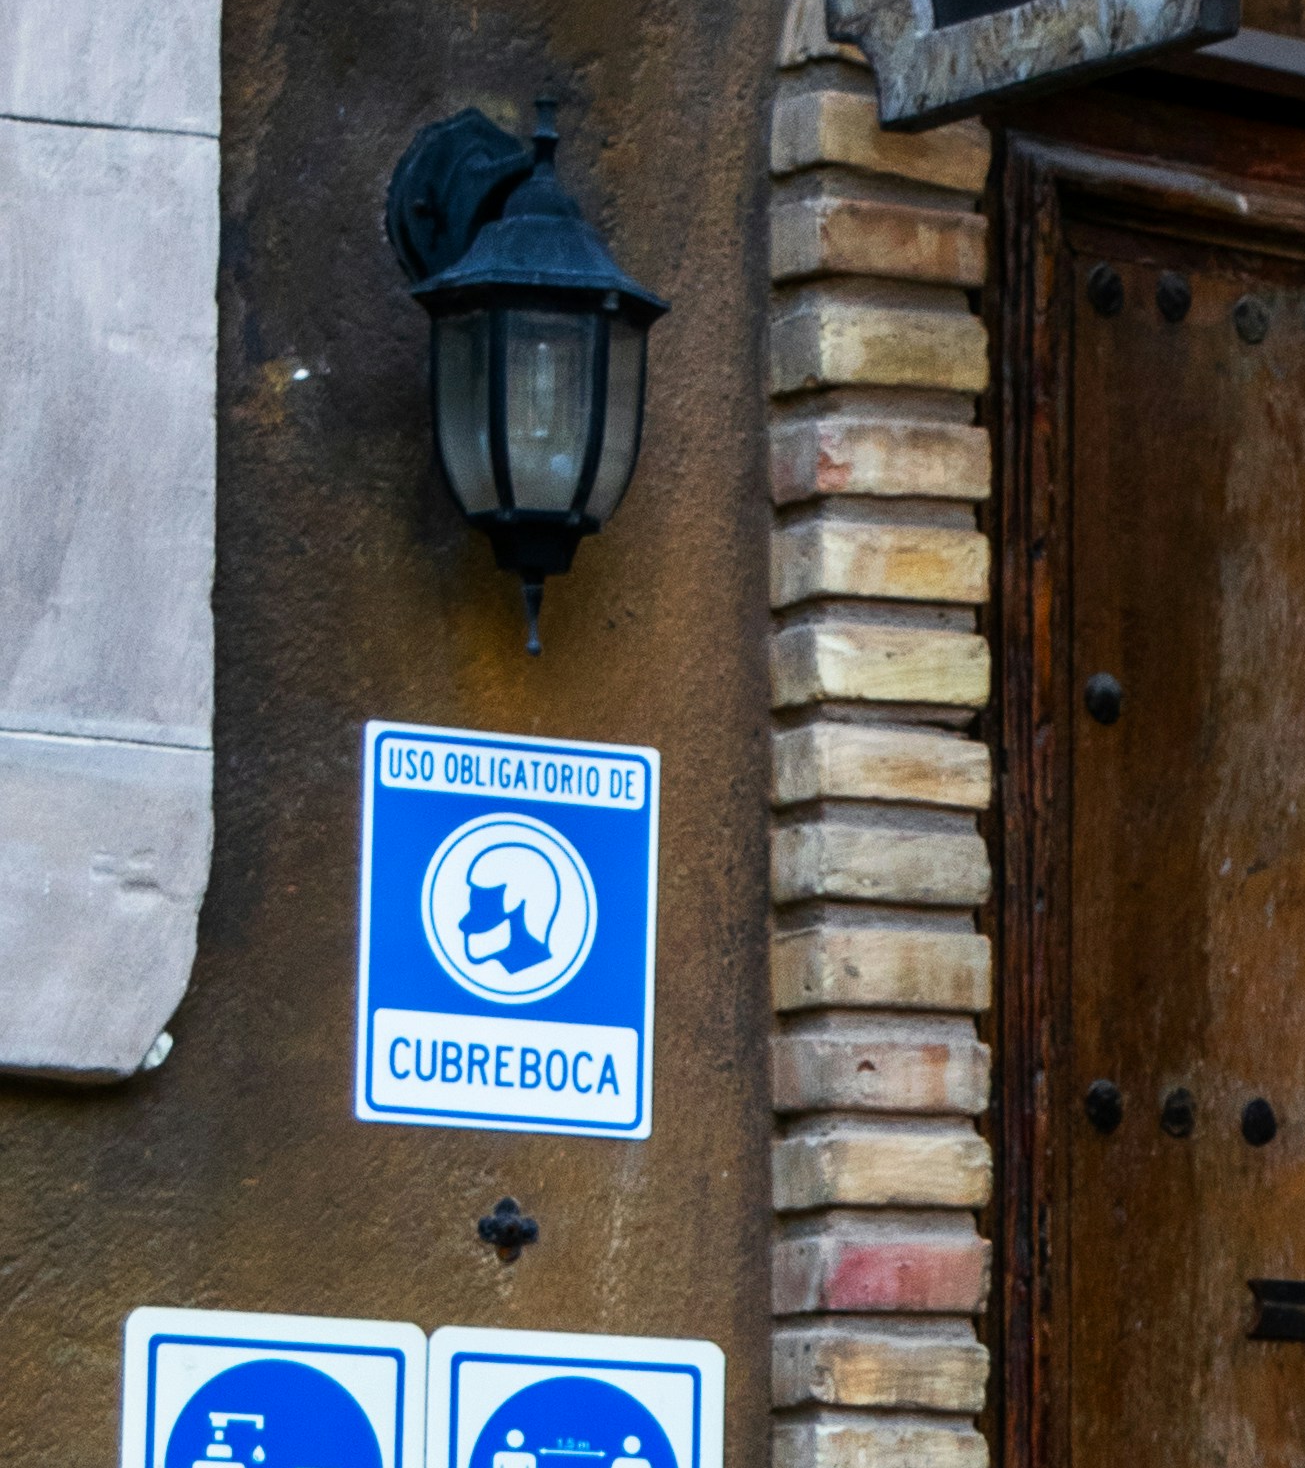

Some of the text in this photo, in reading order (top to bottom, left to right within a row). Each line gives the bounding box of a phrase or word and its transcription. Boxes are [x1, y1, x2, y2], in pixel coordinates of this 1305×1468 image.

[388, 747, 638, 801] USO OBLIGATORIO DE
[388, 1036, 621, 1096] CUBREBOCA
